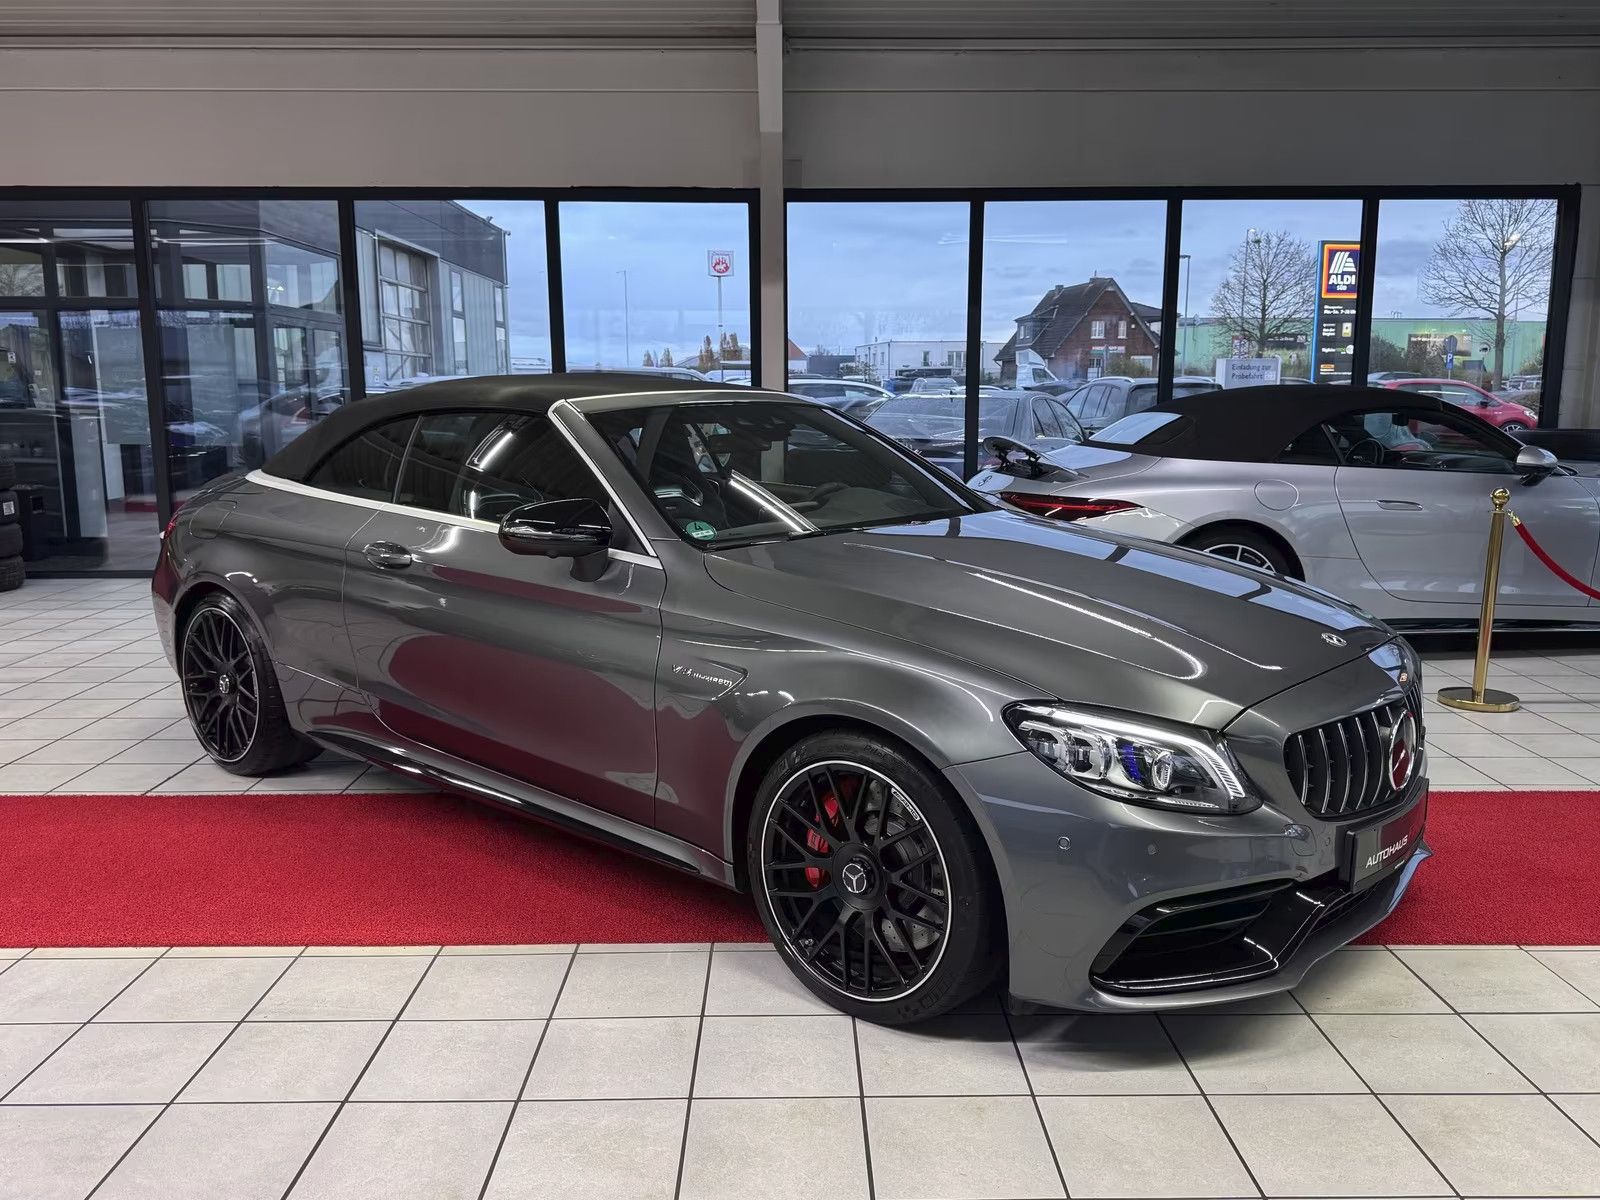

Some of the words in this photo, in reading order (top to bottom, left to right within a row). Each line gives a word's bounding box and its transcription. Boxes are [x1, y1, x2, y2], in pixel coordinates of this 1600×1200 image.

[1328, 274, 1356, 285] ALDI
[1447, 353, 1453, 363] P
[1231, 363, 1261, 371] Einladung
[1231, 372, 1263, 380] Probefahrt
[1365, 834, 1408, 869] AUTOHAUS
